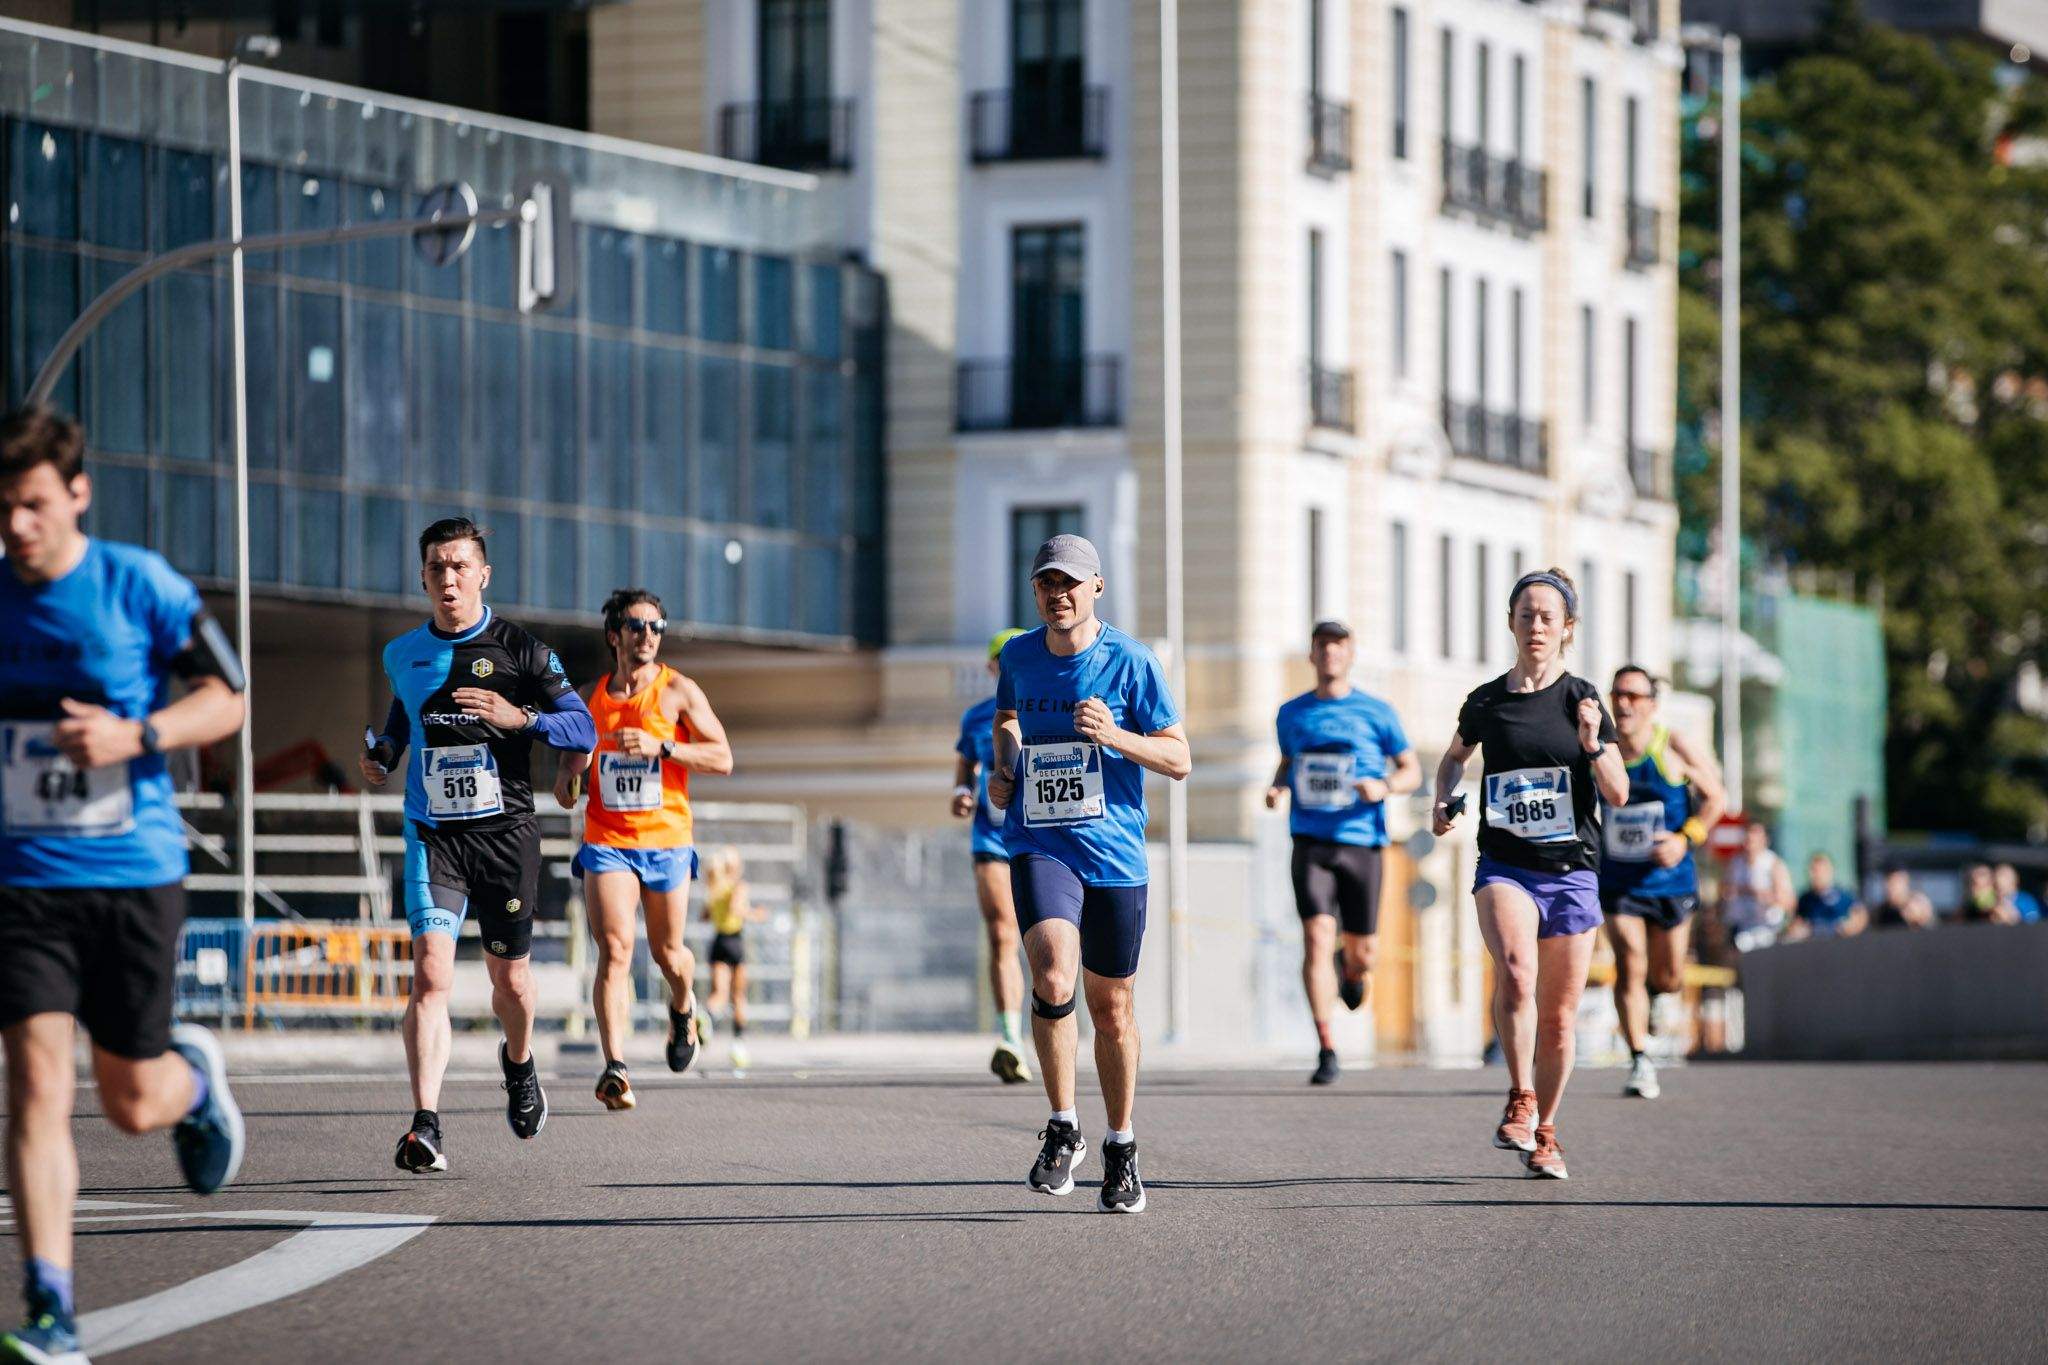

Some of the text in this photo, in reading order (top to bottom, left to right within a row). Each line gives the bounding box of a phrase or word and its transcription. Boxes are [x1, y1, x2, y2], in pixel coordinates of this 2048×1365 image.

[1040, 768, 1082, 777] DECIMAS
[443, 776, 477, 799] 513
[616, 776, 642, 793] 617
[1035, 777, 1085, 803] 1525
[1505, 798, 1556, 824] 1985
